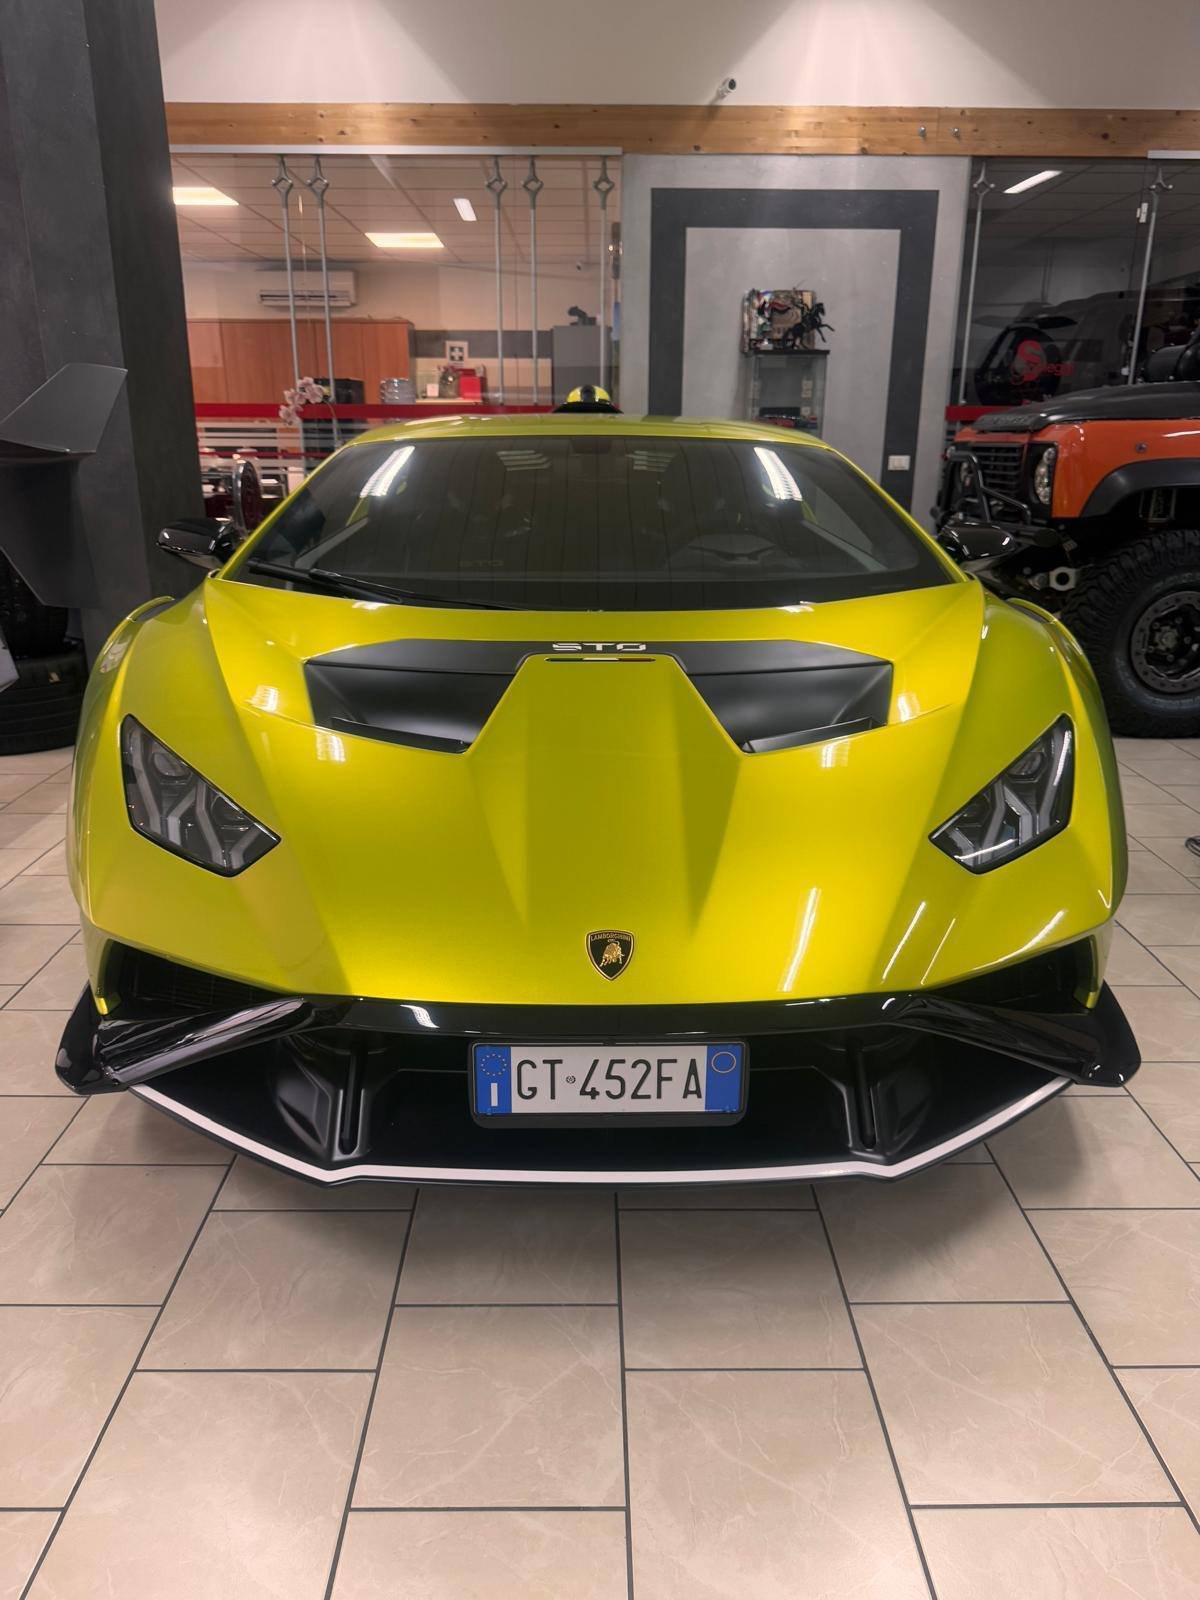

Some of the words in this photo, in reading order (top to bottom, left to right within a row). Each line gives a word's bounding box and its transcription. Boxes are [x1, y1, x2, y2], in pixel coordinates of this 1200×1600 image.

[552, 642, 647, 651] STO
[517, 1059, 563, 1100] GT
[579, 1058, 702, 1100] 452FA
